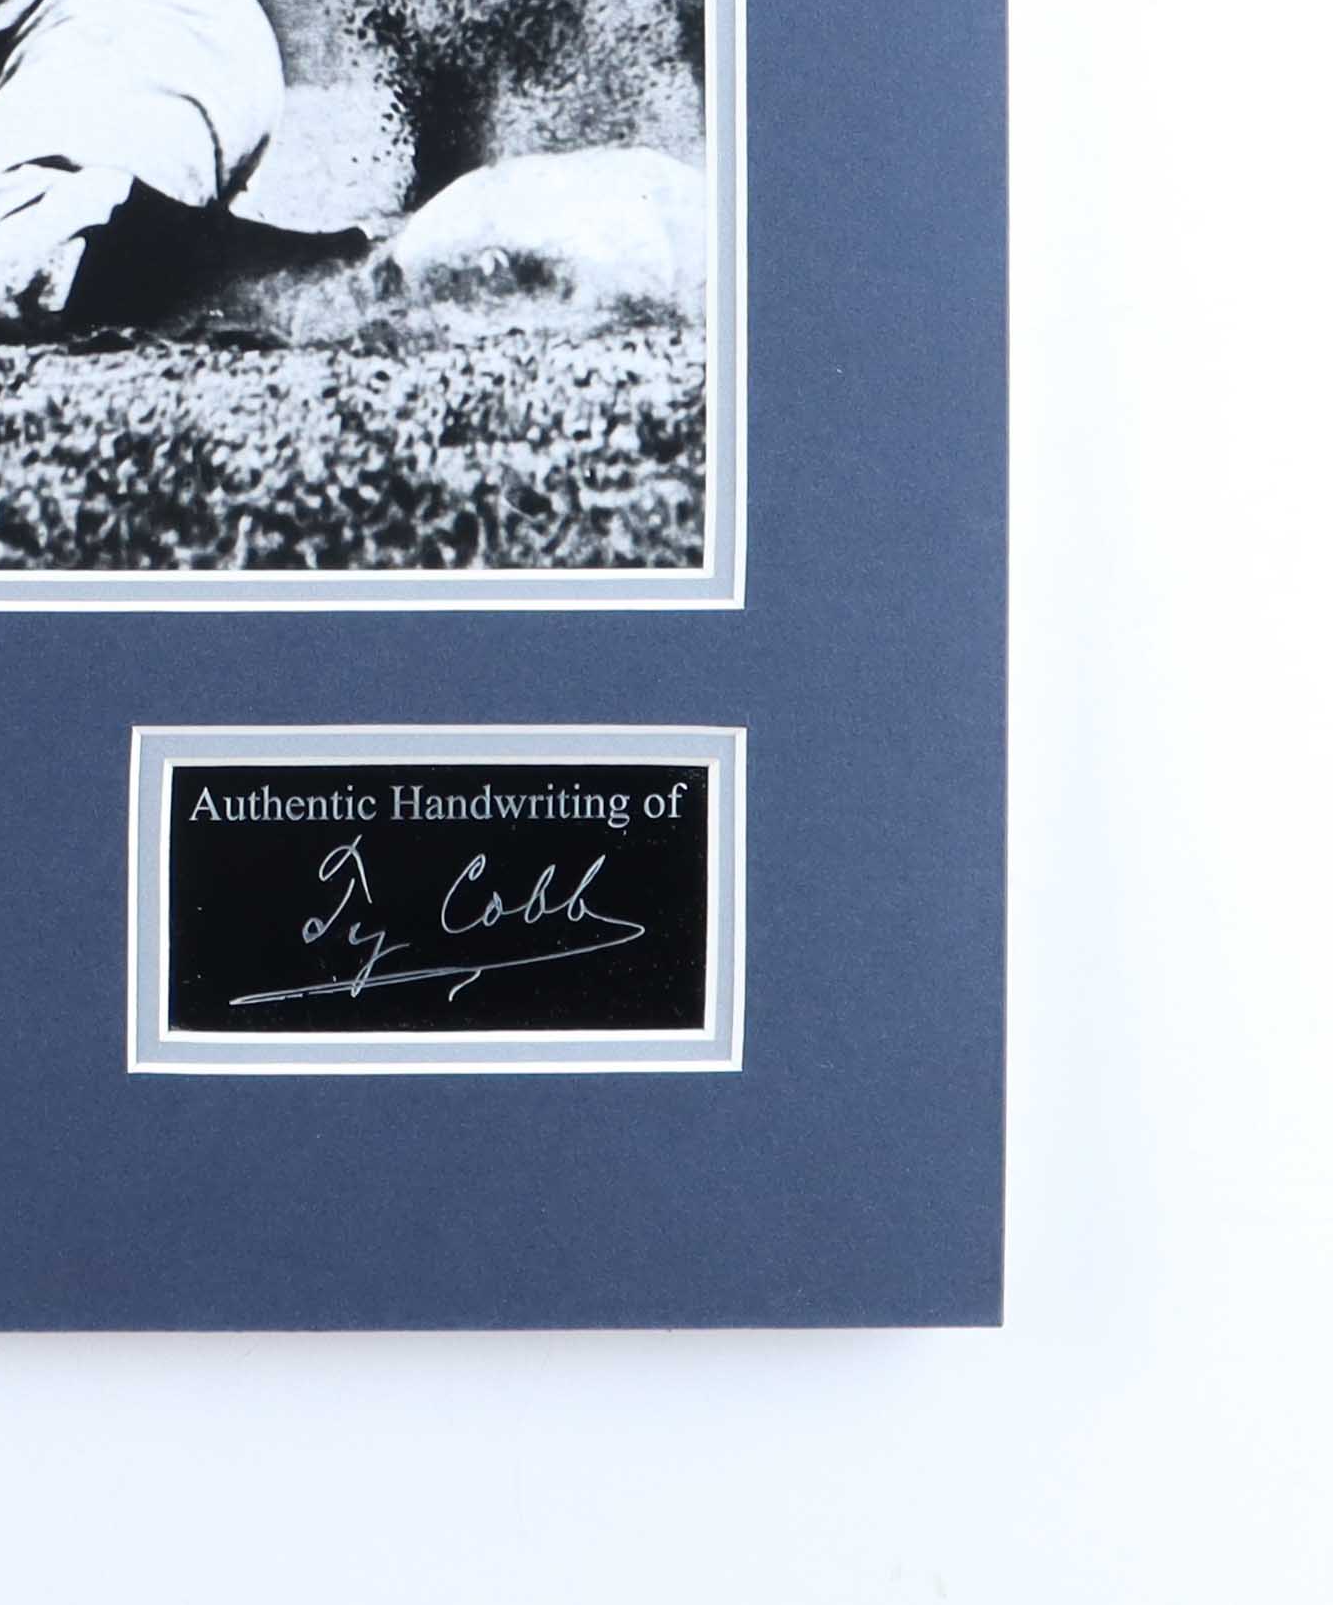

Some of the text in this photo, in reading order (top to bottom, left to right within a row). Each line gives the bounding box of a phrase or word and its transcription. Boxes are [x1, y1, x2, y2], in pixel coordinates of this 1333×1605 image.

[189, 782, 687, 827] Authentic Handwriting of
[302, 834, 645, 998] Ty Cobb
